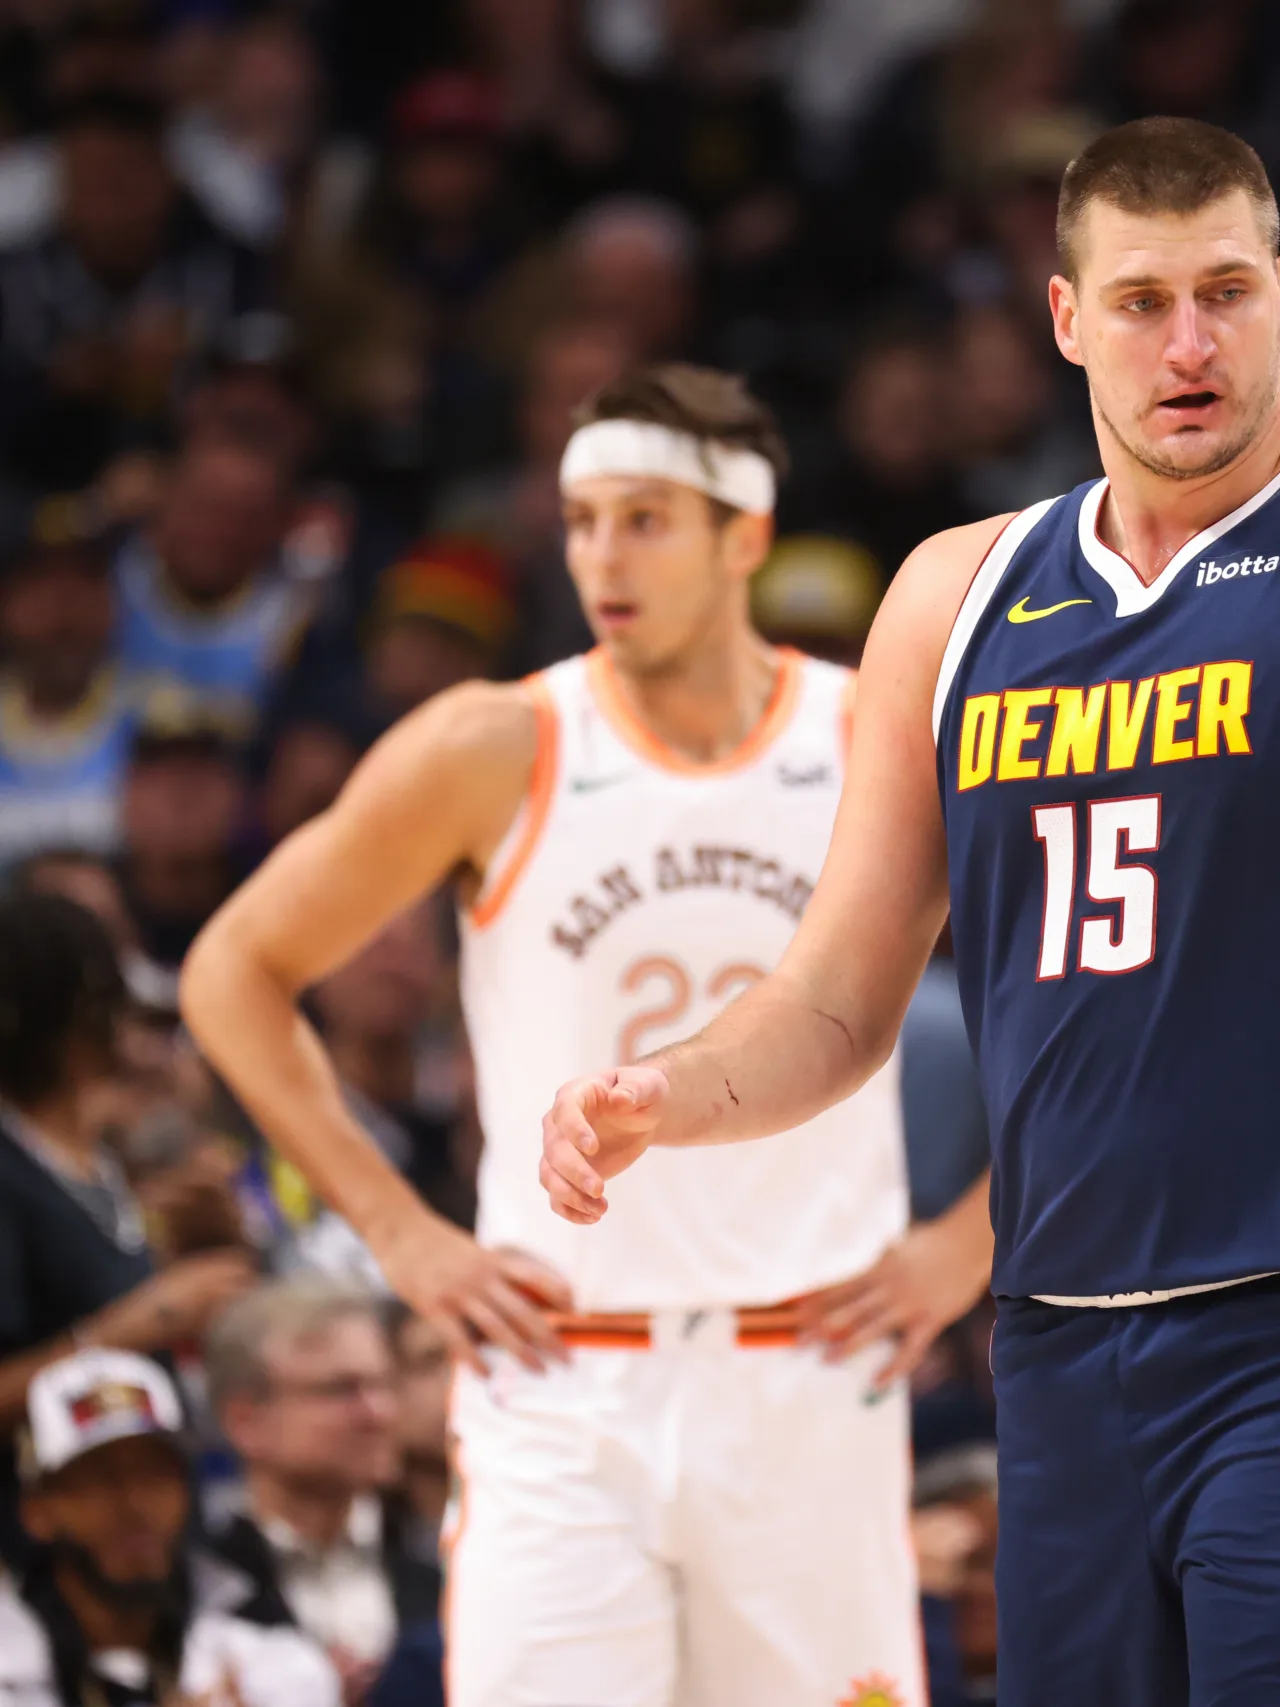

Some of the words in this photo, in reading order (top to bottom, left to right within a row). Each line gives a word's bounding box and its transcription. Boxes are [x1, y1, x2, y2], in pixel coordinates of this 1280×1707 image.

[1196, 556, 1280, 587] ibotta
[957, 660, 1254, 793] DENVER
[551, 865, 641, 959] SAN
[1031, 793, 1162, 983] 15
[617, 953, 770, 1067] 2
